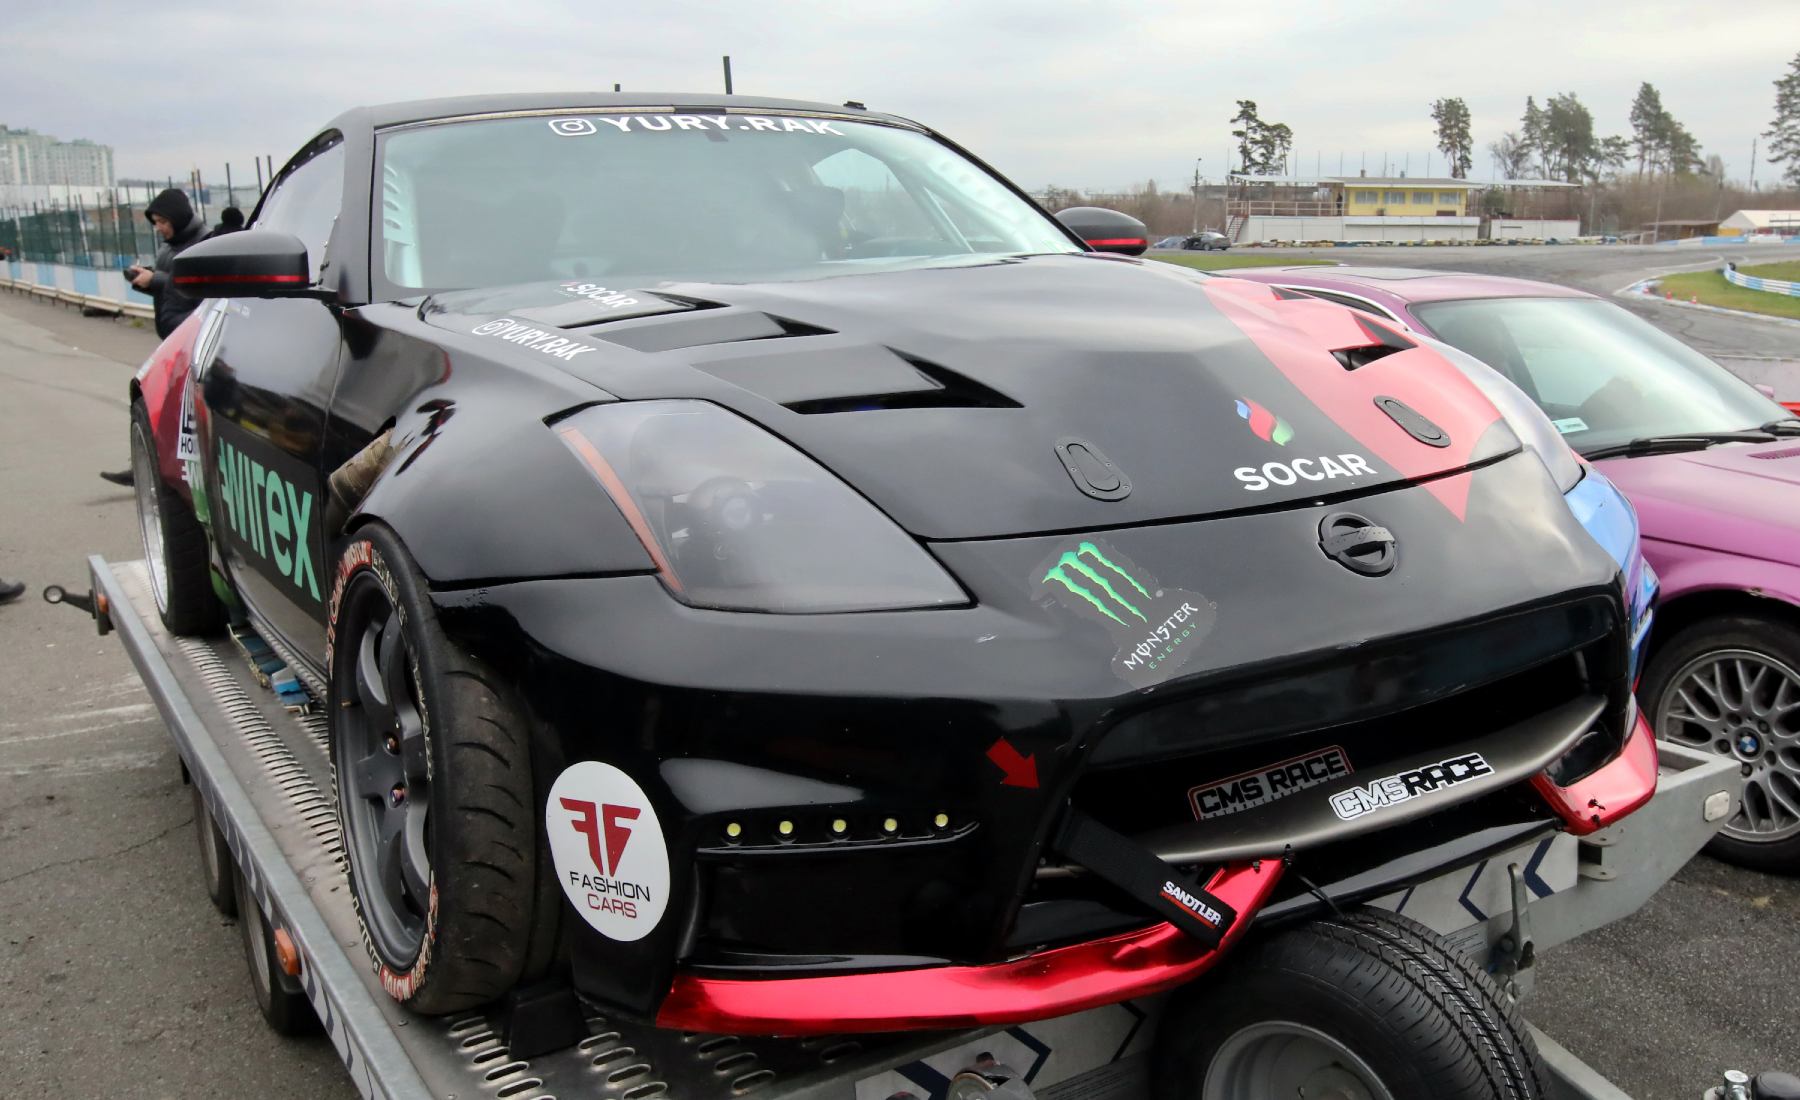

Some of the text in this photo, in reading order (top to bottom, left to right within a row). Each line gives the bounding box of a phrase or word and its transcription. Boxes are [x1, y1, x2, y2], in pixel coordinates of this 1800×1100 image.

[599, 114, 845, 137] YURY.RAK
[566, 283, 639, 308] SOCAR
[1233, 453, 1378, 491] SOCAR
[1123, 601, 1199, 671] MONSTER
[1148, 622, 1198, 670] ENERGY
[1195, 775, 1265, 816] CMS
[1270, 749, 1347, 794] RACE
[569, 870, 651, 902] FASHION
[1162, 880, 1222, 926] SANDTLER
[587, 892, 638, 919] CARS
